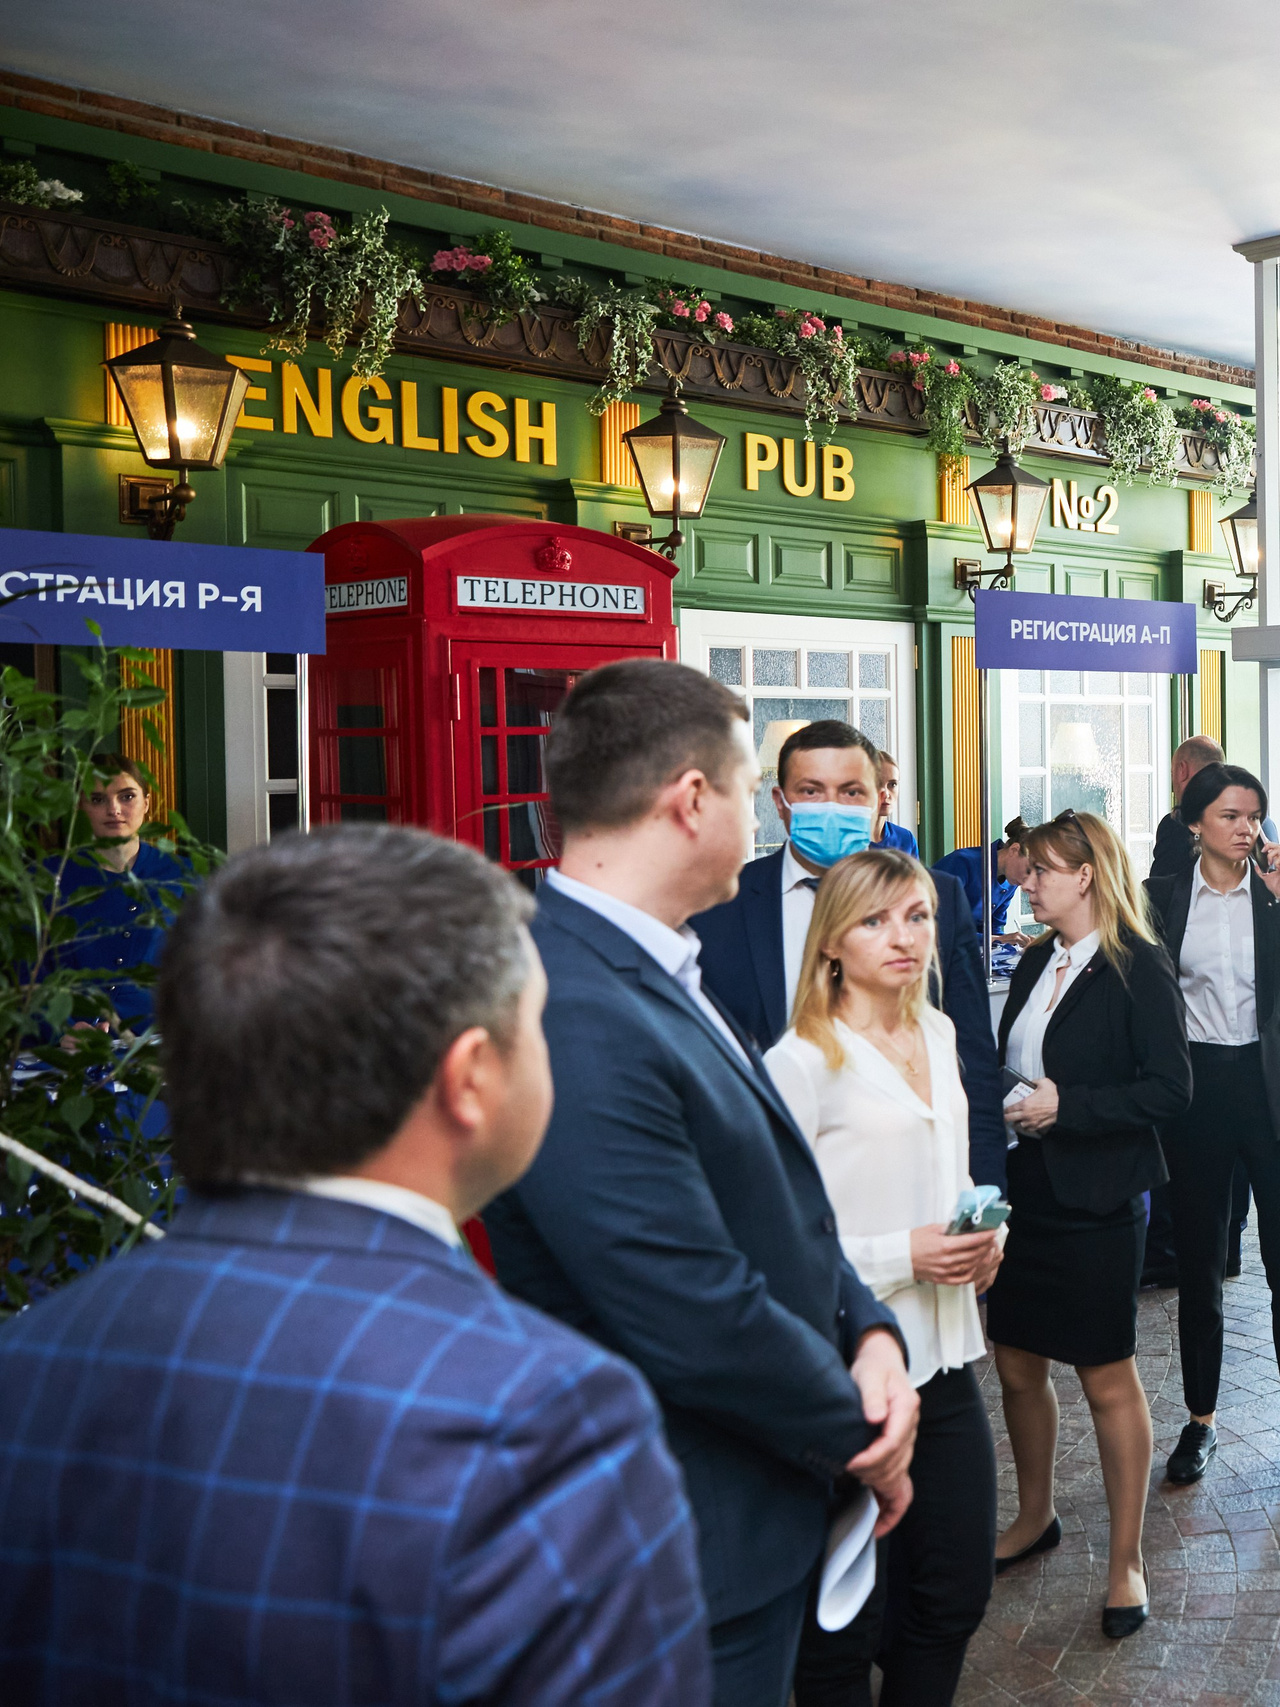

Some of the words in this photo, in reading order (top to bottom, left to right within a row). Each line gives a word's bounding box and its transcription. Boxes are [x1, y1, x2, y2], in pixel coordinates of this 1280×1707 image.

[225, 354, 557, 466] ENGLISH
[745, 432, 856, 502] PUB
[1050, 477, 1120, 535] №2
[198, 582, 262, 612] Р-Я
[464, 578, 639, 610] TELEPHONE
[1010, 619, 1136, 646] РЕГИСТРАЦИЯ
[1140, 625, 1171, 645] А-П
